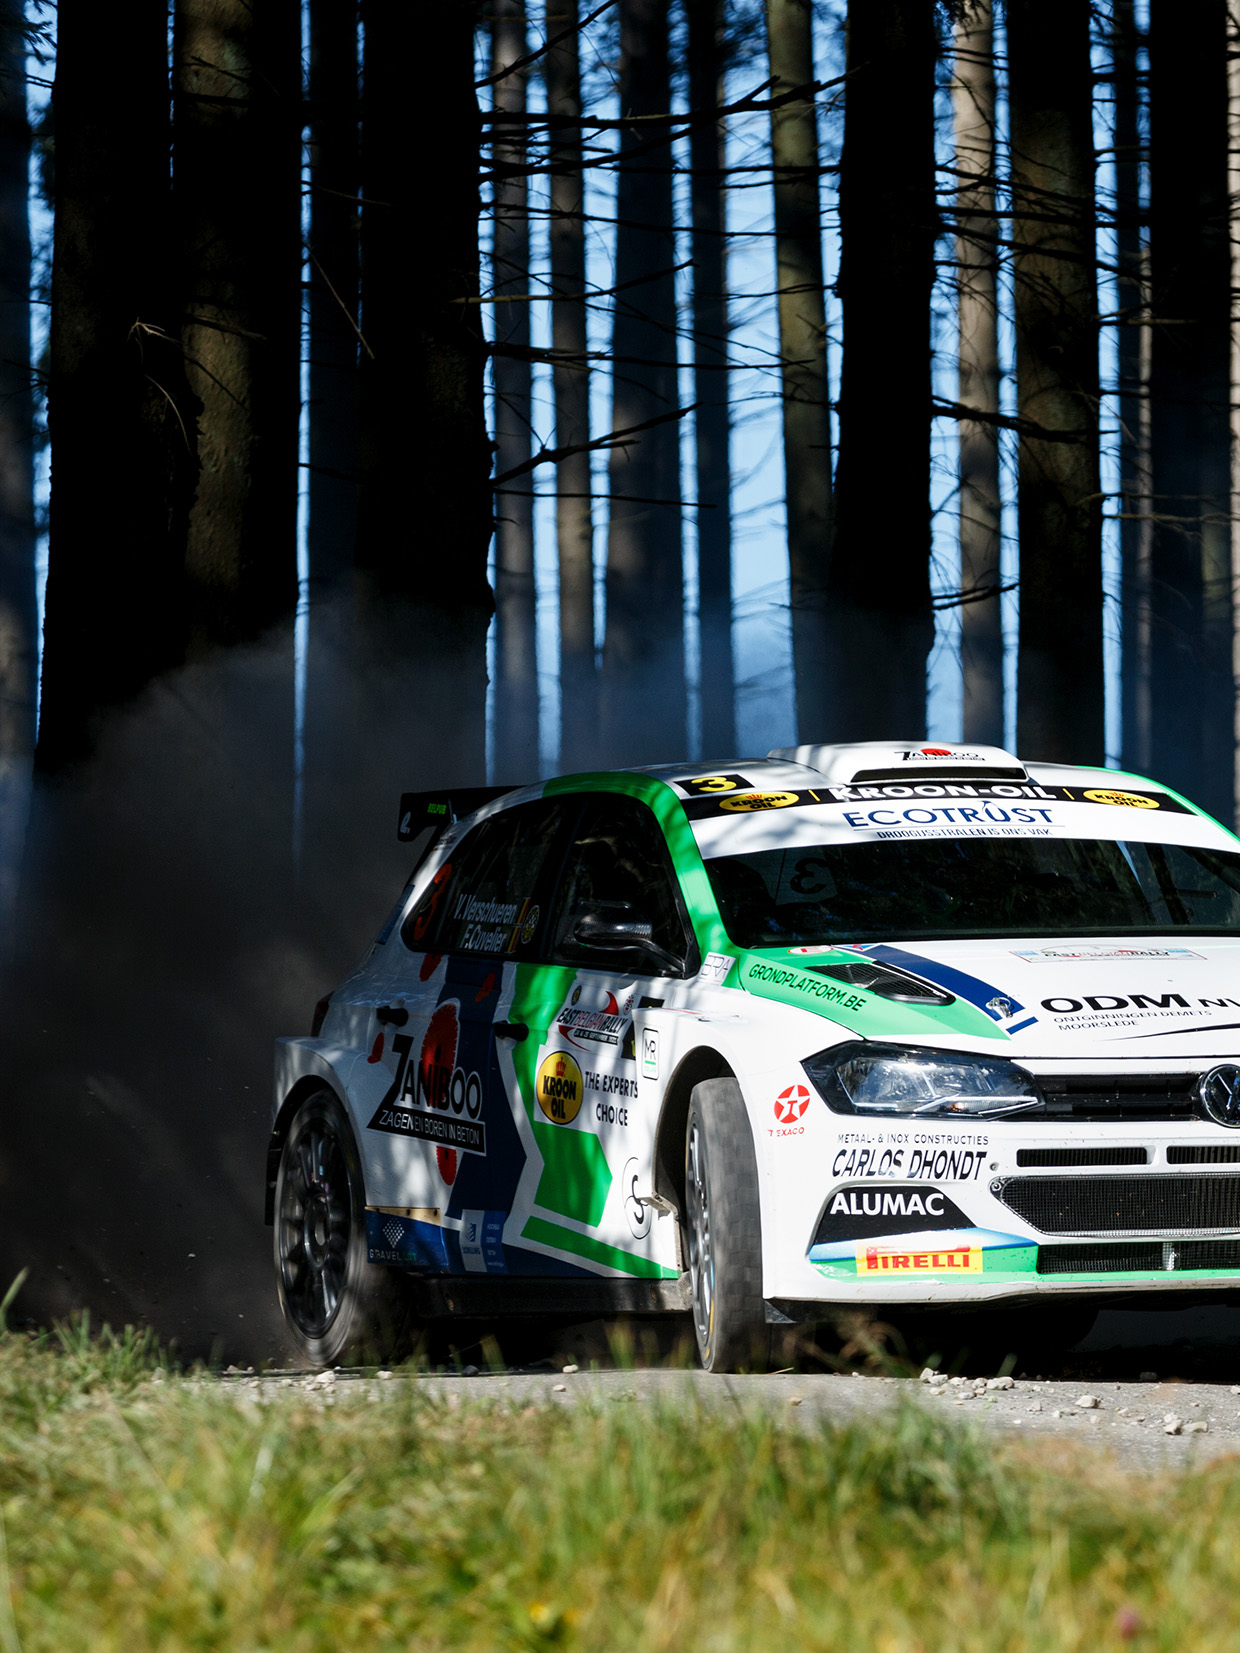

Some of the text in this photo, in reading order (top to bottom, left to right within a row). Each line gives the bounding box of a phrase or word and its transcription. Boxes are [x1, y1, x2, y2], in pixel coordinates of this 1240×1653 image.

[690, 776, 738, 792] 3
[828, 784, 1057, 801] KROON-OIL
[729, 795, 788, 807] KROON
[988, 828, 1000, 836] IS
[1001, 828, 1024, 836] ONS
[1027, 828, 1053, 836] VAK
[748, 963, 867, 1012] GRONDPLATFORM.BE
[1040, 993, 1190, 1013] ODM
[1058, 1020, 1139, 1031] MOORSLEDE
[543, 1075, 577, 1100] KROON
[584, 1071, 638, 1099] THE EXPERTS
[551, 1097, 566, 1119] OIL
[596, 1103, 628, 1127] CHOICE
[379, 1109, 414, 1130] ZAGEN
[424, 1117, 447, 1137] BOREN
[457, 1126, 480, 1145] BETON
[768, 1127, 804, 1137] TEXACO
[878, 1134, 884, 1143] &
[887, 1134, 909, 1144] INOX
[915, 1134, 989, 1145] CONSTRUCTIES
[832, 1149, 987, 1180] CARLOS DHONDT
[830, 1193, 944, 1216] ALUMAC
[866, 1245, 971, 1270] PIRELLI
